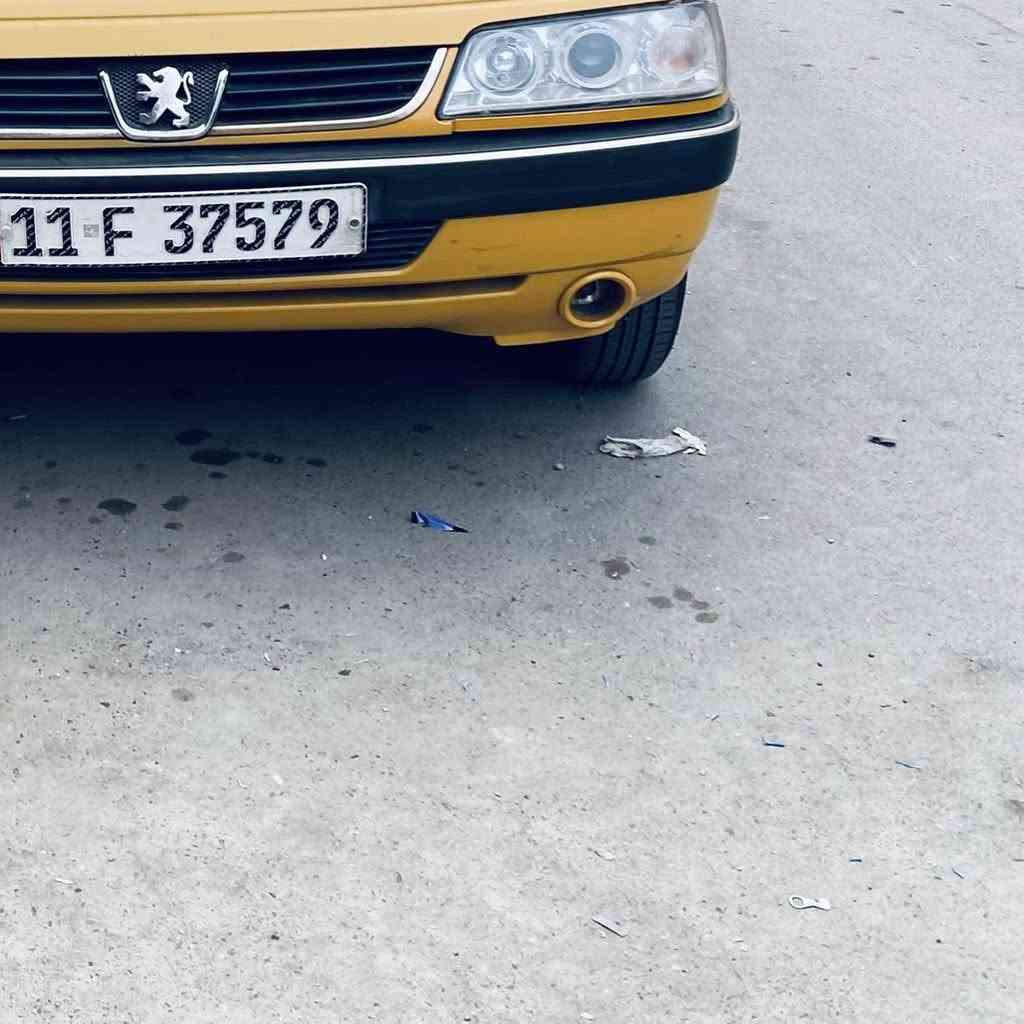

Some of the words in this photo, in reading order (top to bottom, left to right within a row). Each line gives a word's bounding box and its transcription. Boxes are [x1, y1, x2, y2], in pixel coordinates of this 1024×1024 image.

[10, 206, 78, 257] 11
[103, 206, 134, 256] F
[163, 198, 339, 254] 37579
